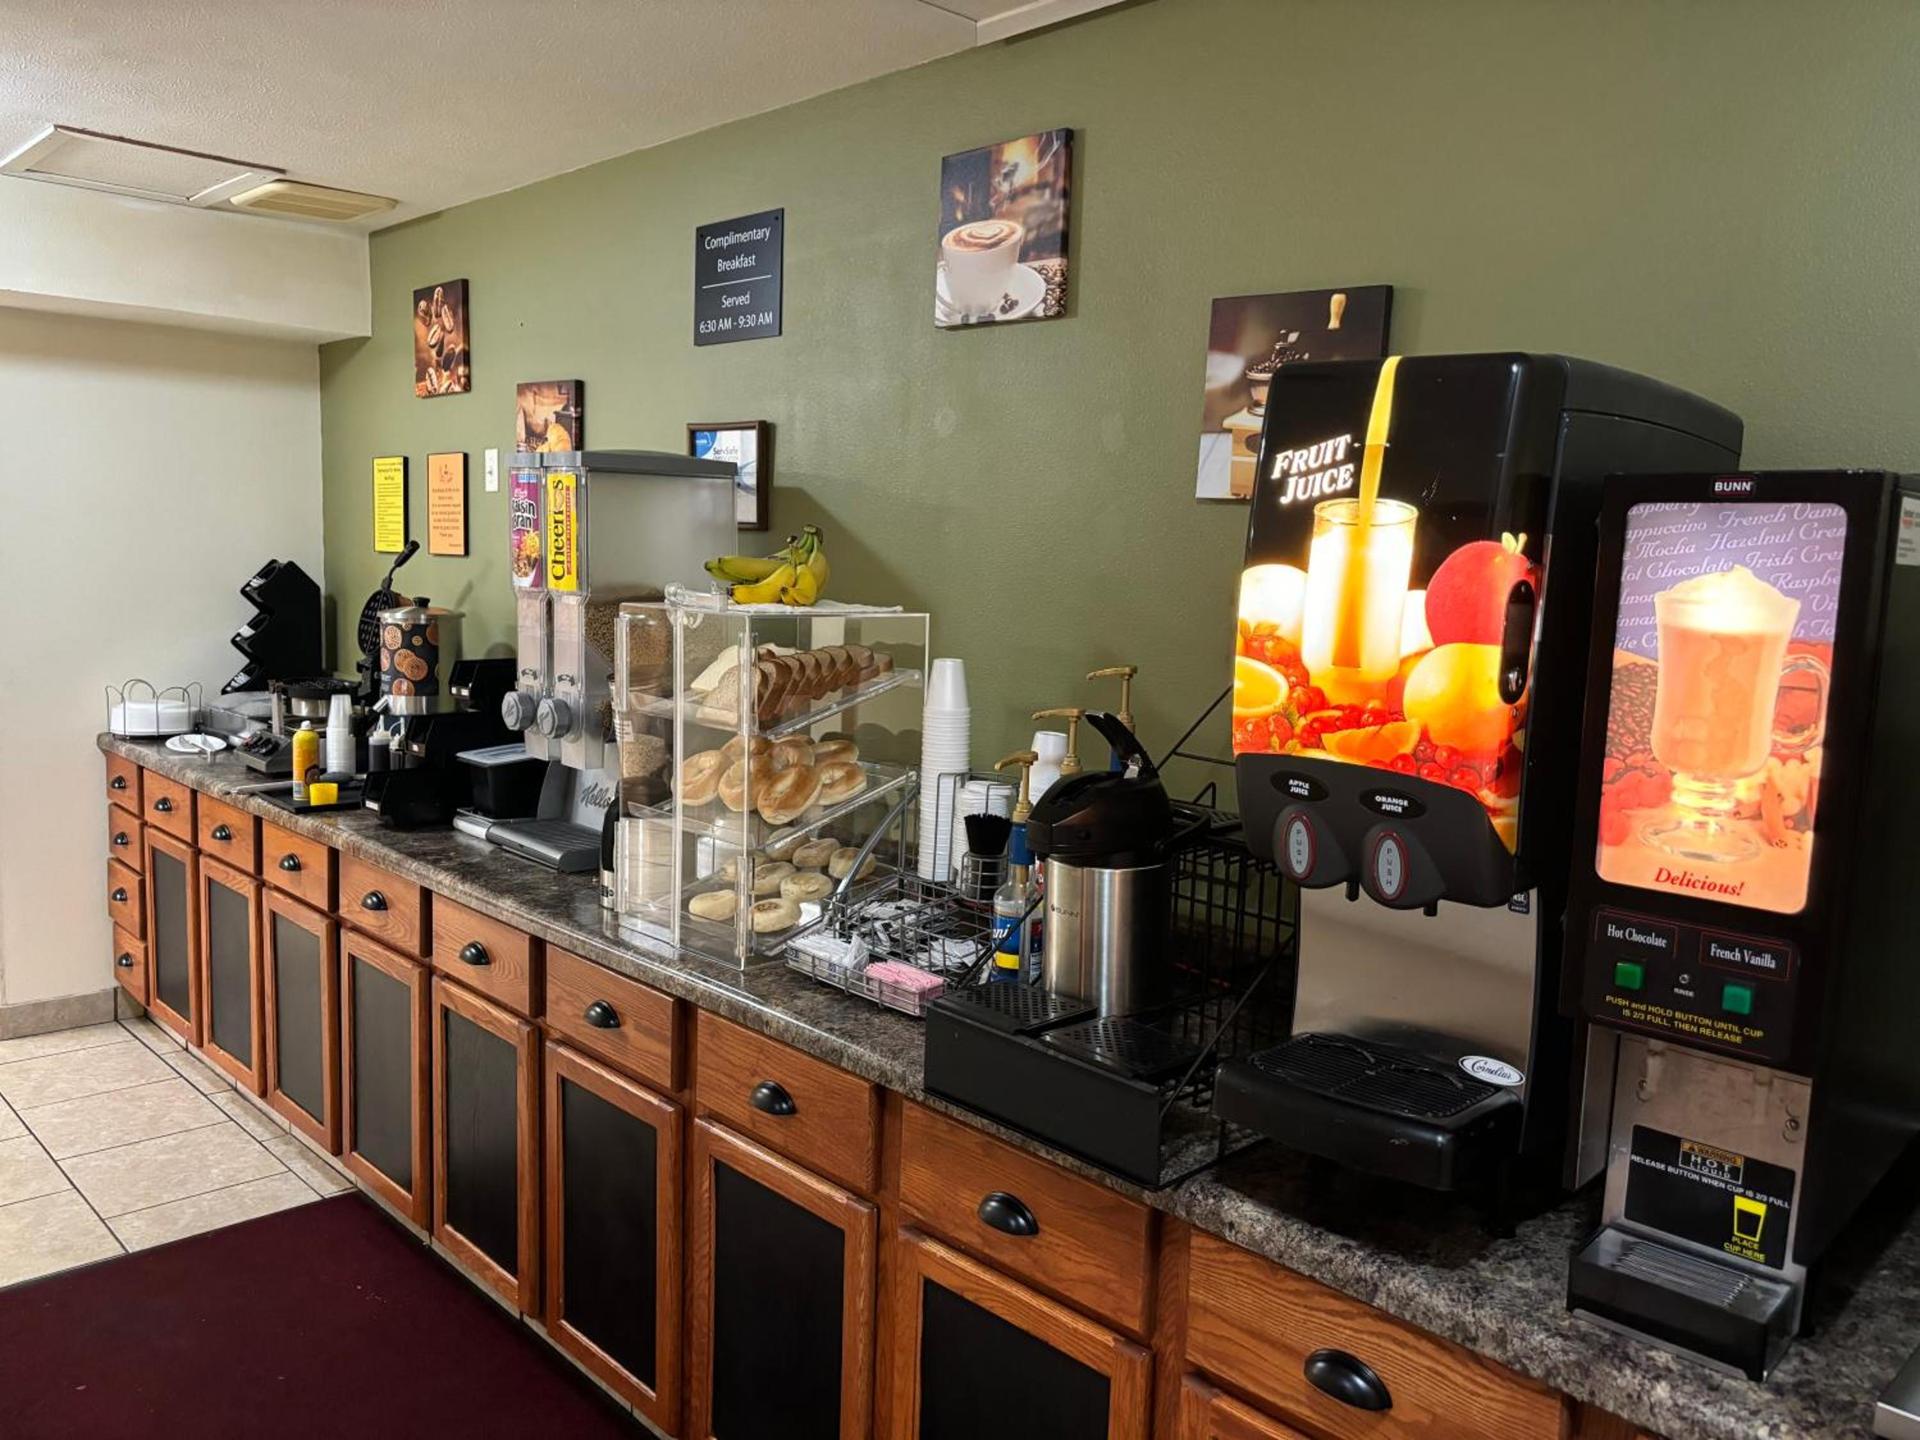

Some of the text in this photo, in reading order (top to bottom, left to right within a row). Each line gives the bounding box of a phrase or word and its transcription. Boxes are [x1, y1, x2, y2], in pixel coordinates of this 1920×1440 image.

[705, 227, 771, 250] Complimentary
[717, 253, 756, 272] Breakfast
[721, 291, 751, 308] Served
[699, 319, 716, 334] 6:30
[718, 317, 732, 330] AM
[738, 313, 756, 328] 9:30
[758, 311, 773, 325] AM
[1271, 434, 1351, 479] FRUIT
[1280, 463, 1354, 504] JUICE
[1714, 481, 1751, 492] BUNN
[1635, 537, 1696, 559] Mocha
[1647, 556, 1733, 580] Chocolate
[1288, 779, 1310, 789] APPLE
[1290, 786, 1309, 796] JUICE
[1375, 795, 1408, 807] ORANGE
[1381, 803, 1402, 813] JUICE
[1654, 867, 1745, 896] Delicious!
[1607, 923, 1668, 948] Hot Chocolate
[1710, 943, 1776, 968] French Vanilla
[1605, 995, 1764, 1037] PUSH and HOLD BUTTON UNTIL CUP
[1622, 1008, 1631, 1017] IS
[1633, 1011, 1645, 1020] 2/3
[1674, 1021, 1698, 1033] THEN
[1699, 1027, 1743, 1044] RELEASE
[1691, 1153, 1730, 1171] HOT
[1631, 1154, 1666, 1171] RELEASE
[1667, 1165, 1700, 1181] BUTTON
[1701, 1176, 1726, 1189] WHEN
[1727, 1184, 1744, 1193] CUP
[1769, 1196, 1790, 1209] FULL
[1723, 1242, 1766, 1262] CUP HERE
[1732, 1236, 1759, 1249] PLACE
